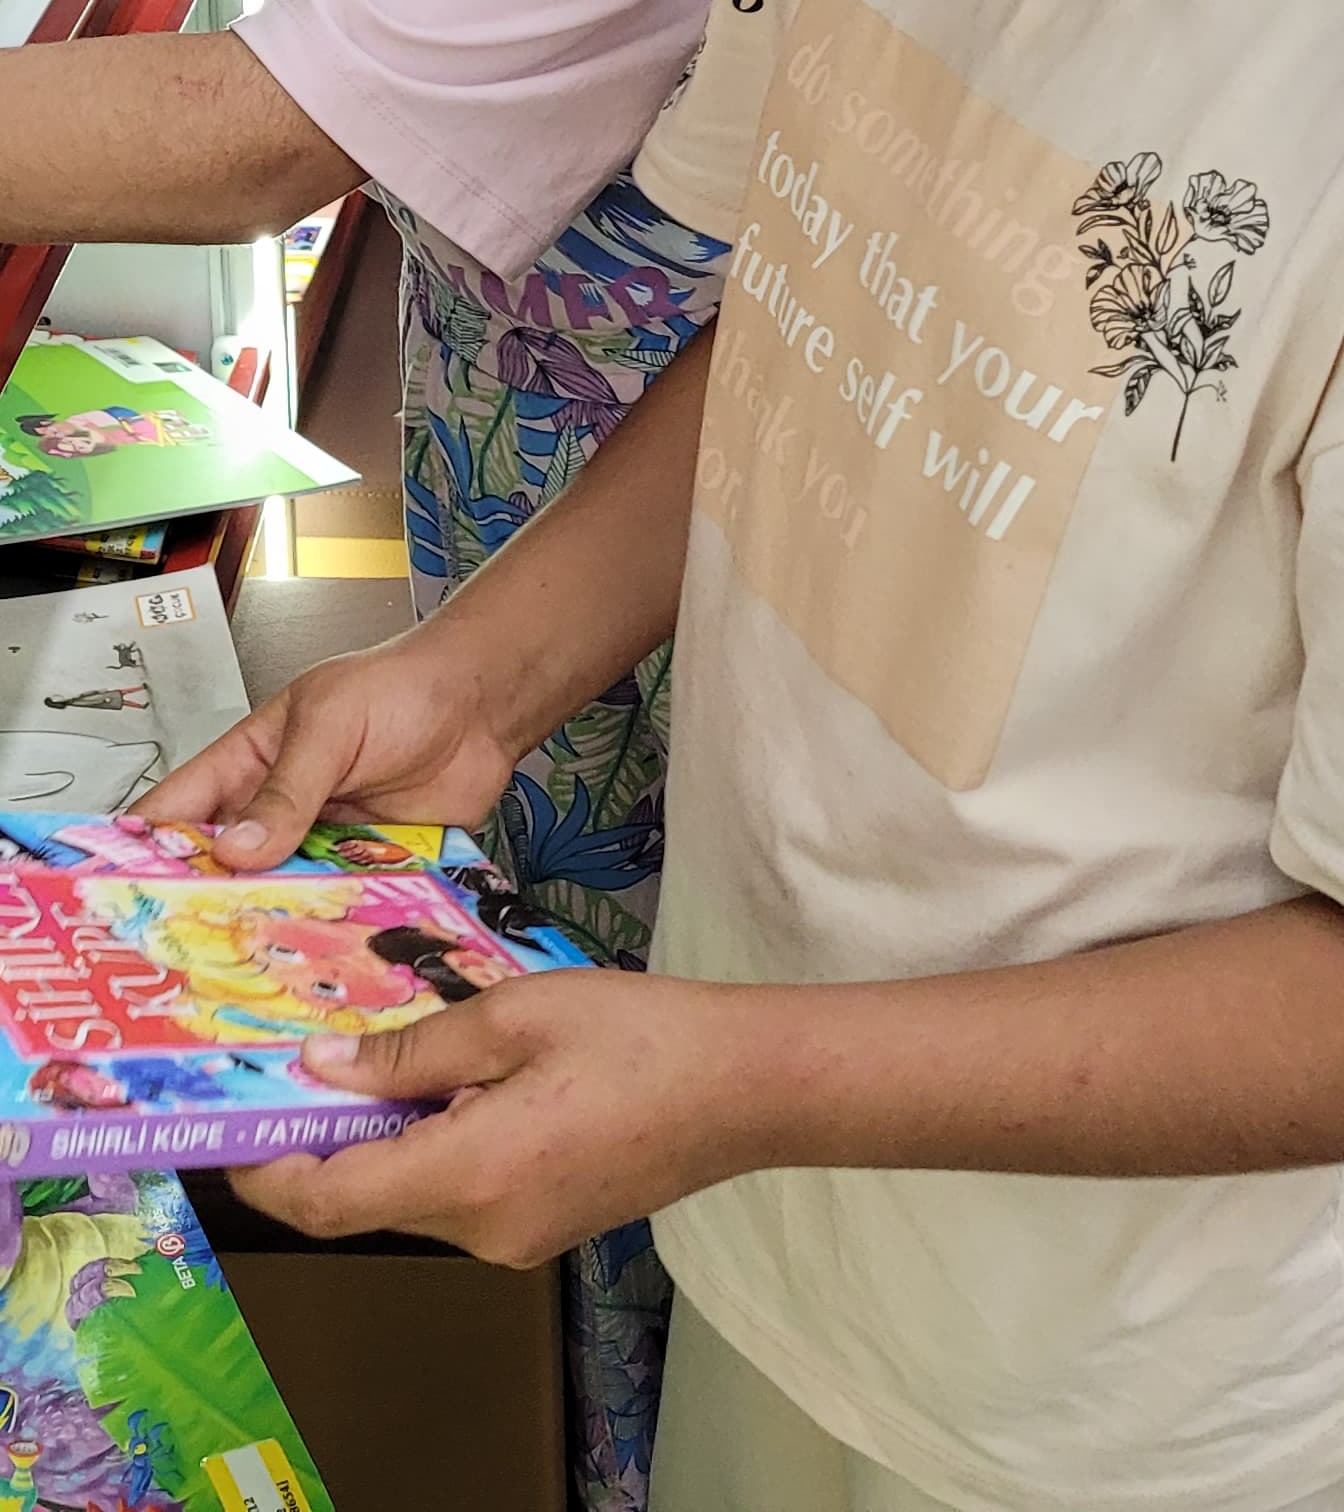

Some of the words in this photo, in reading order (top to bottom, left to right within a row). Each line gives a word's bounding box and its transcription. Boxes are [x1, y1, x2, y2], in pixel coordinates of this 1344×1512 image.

[759, 130, 852, 269] today
[859, 230, 937, 345] that
[937, 318, 1105, 444] your
[732, 223, 837, 373] future
[839, 356, 923, 451] self
[921, 428, 1035, 542] will
[152, 1117, 224, 1153] KÜPE
[254, 1113, 330, 1149] FATİH
[172, 1256, 196, 1289] BETA
